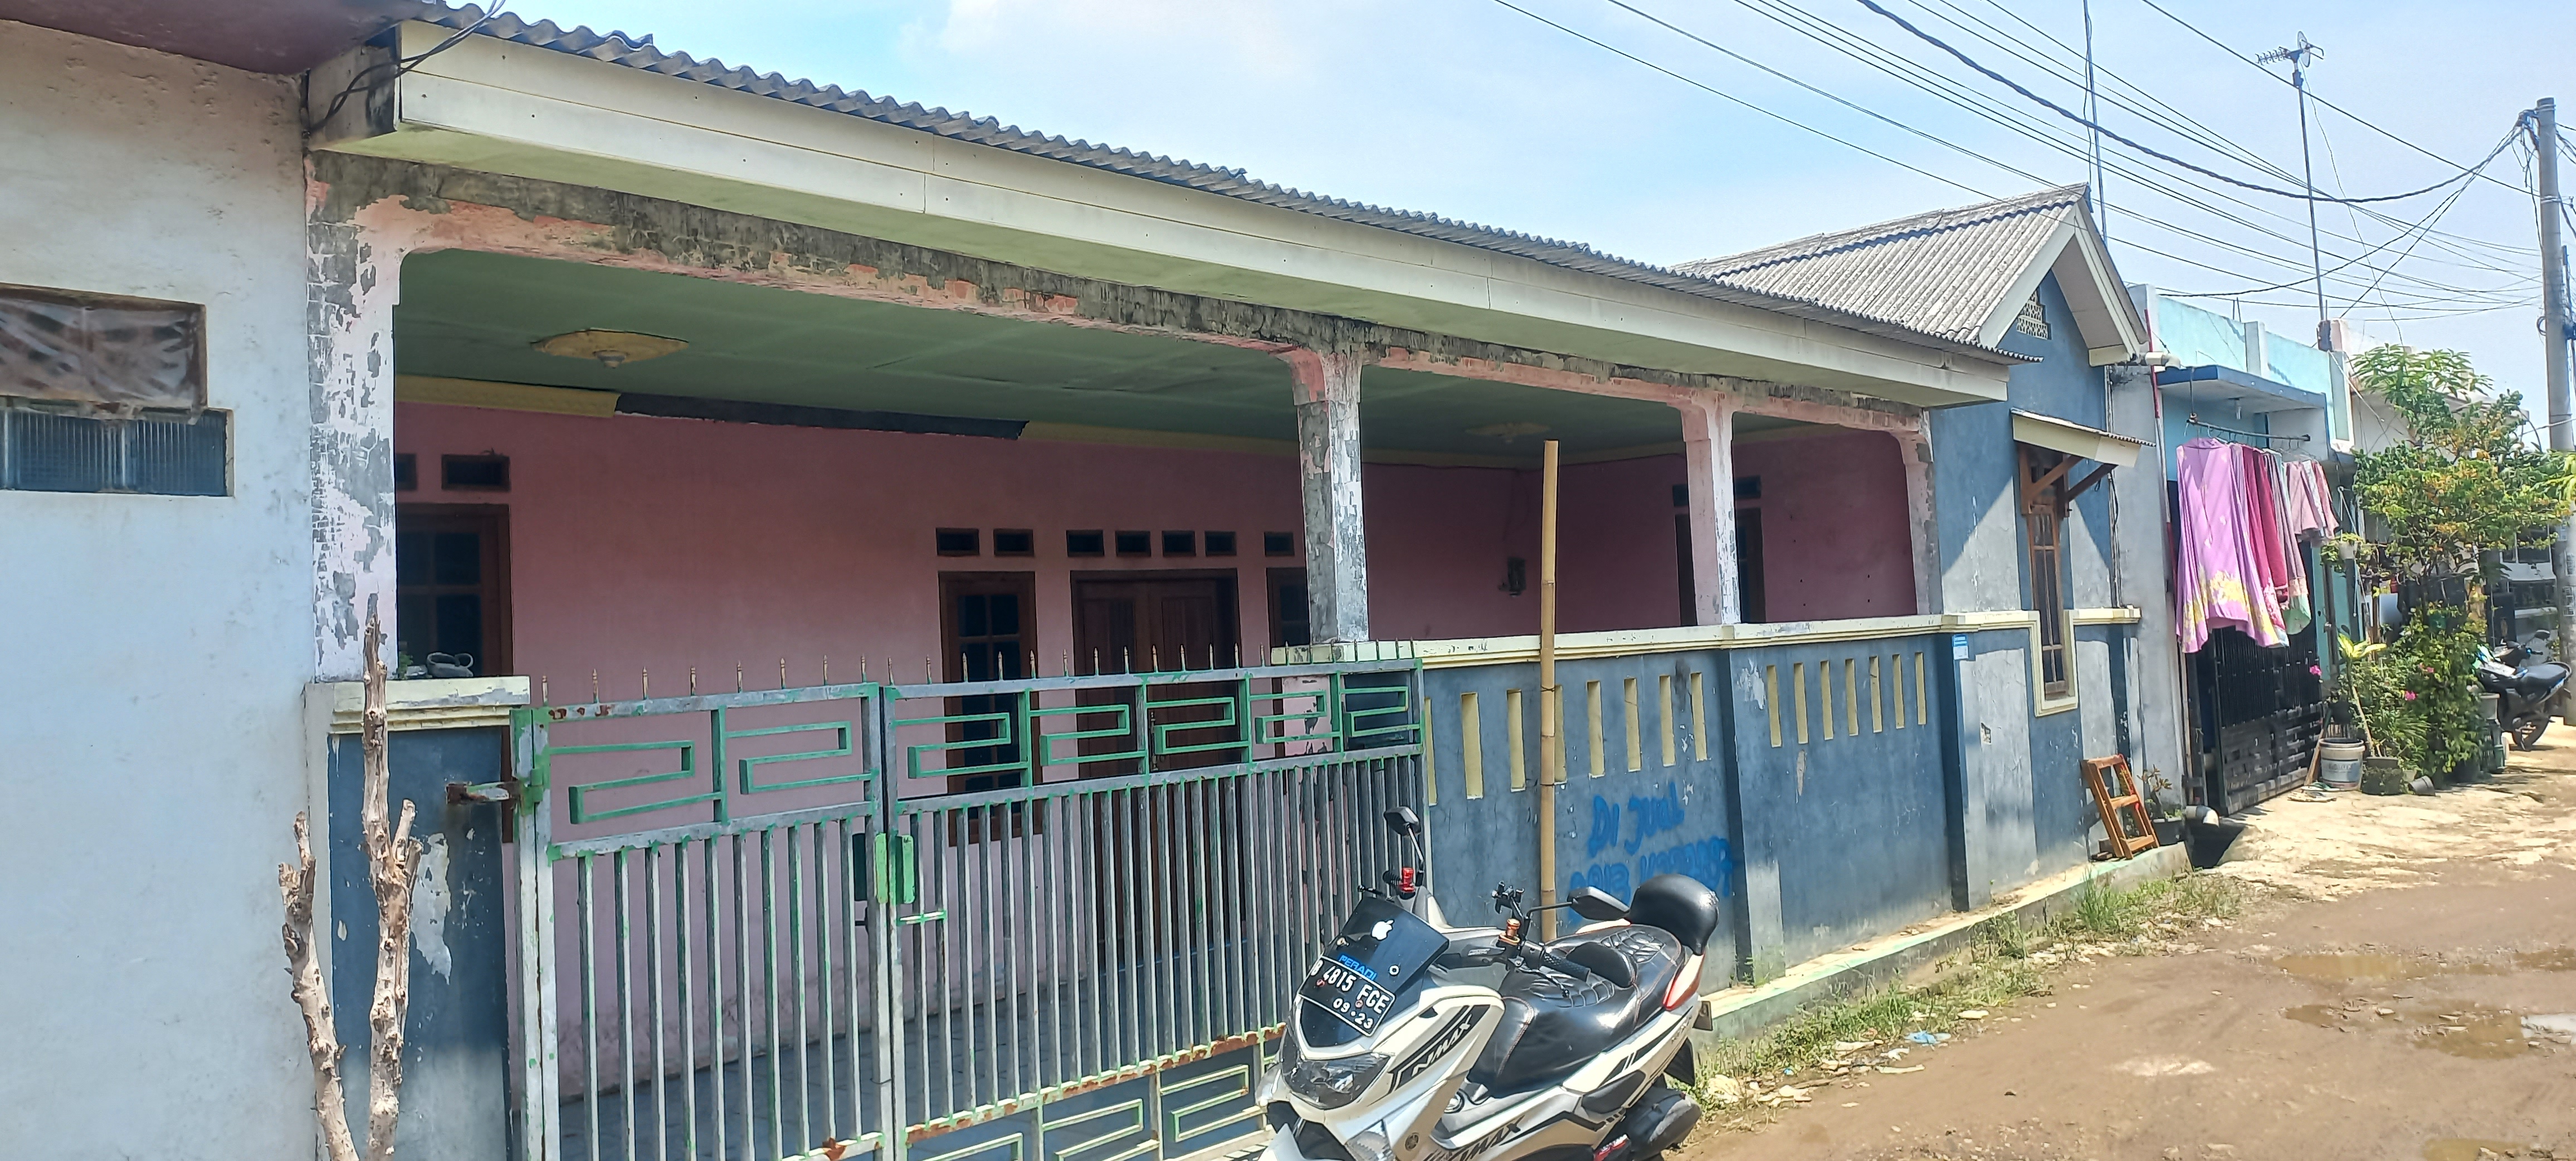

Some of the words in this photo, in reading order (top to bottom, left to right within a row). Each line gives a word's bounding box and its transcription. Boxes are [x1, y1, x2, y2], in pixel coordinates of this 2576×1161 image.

[1310, 959, 1324, 976] B
[1323, 965, 1357, 992] 4815
[1339, 955, 1378, 980] PERADI
